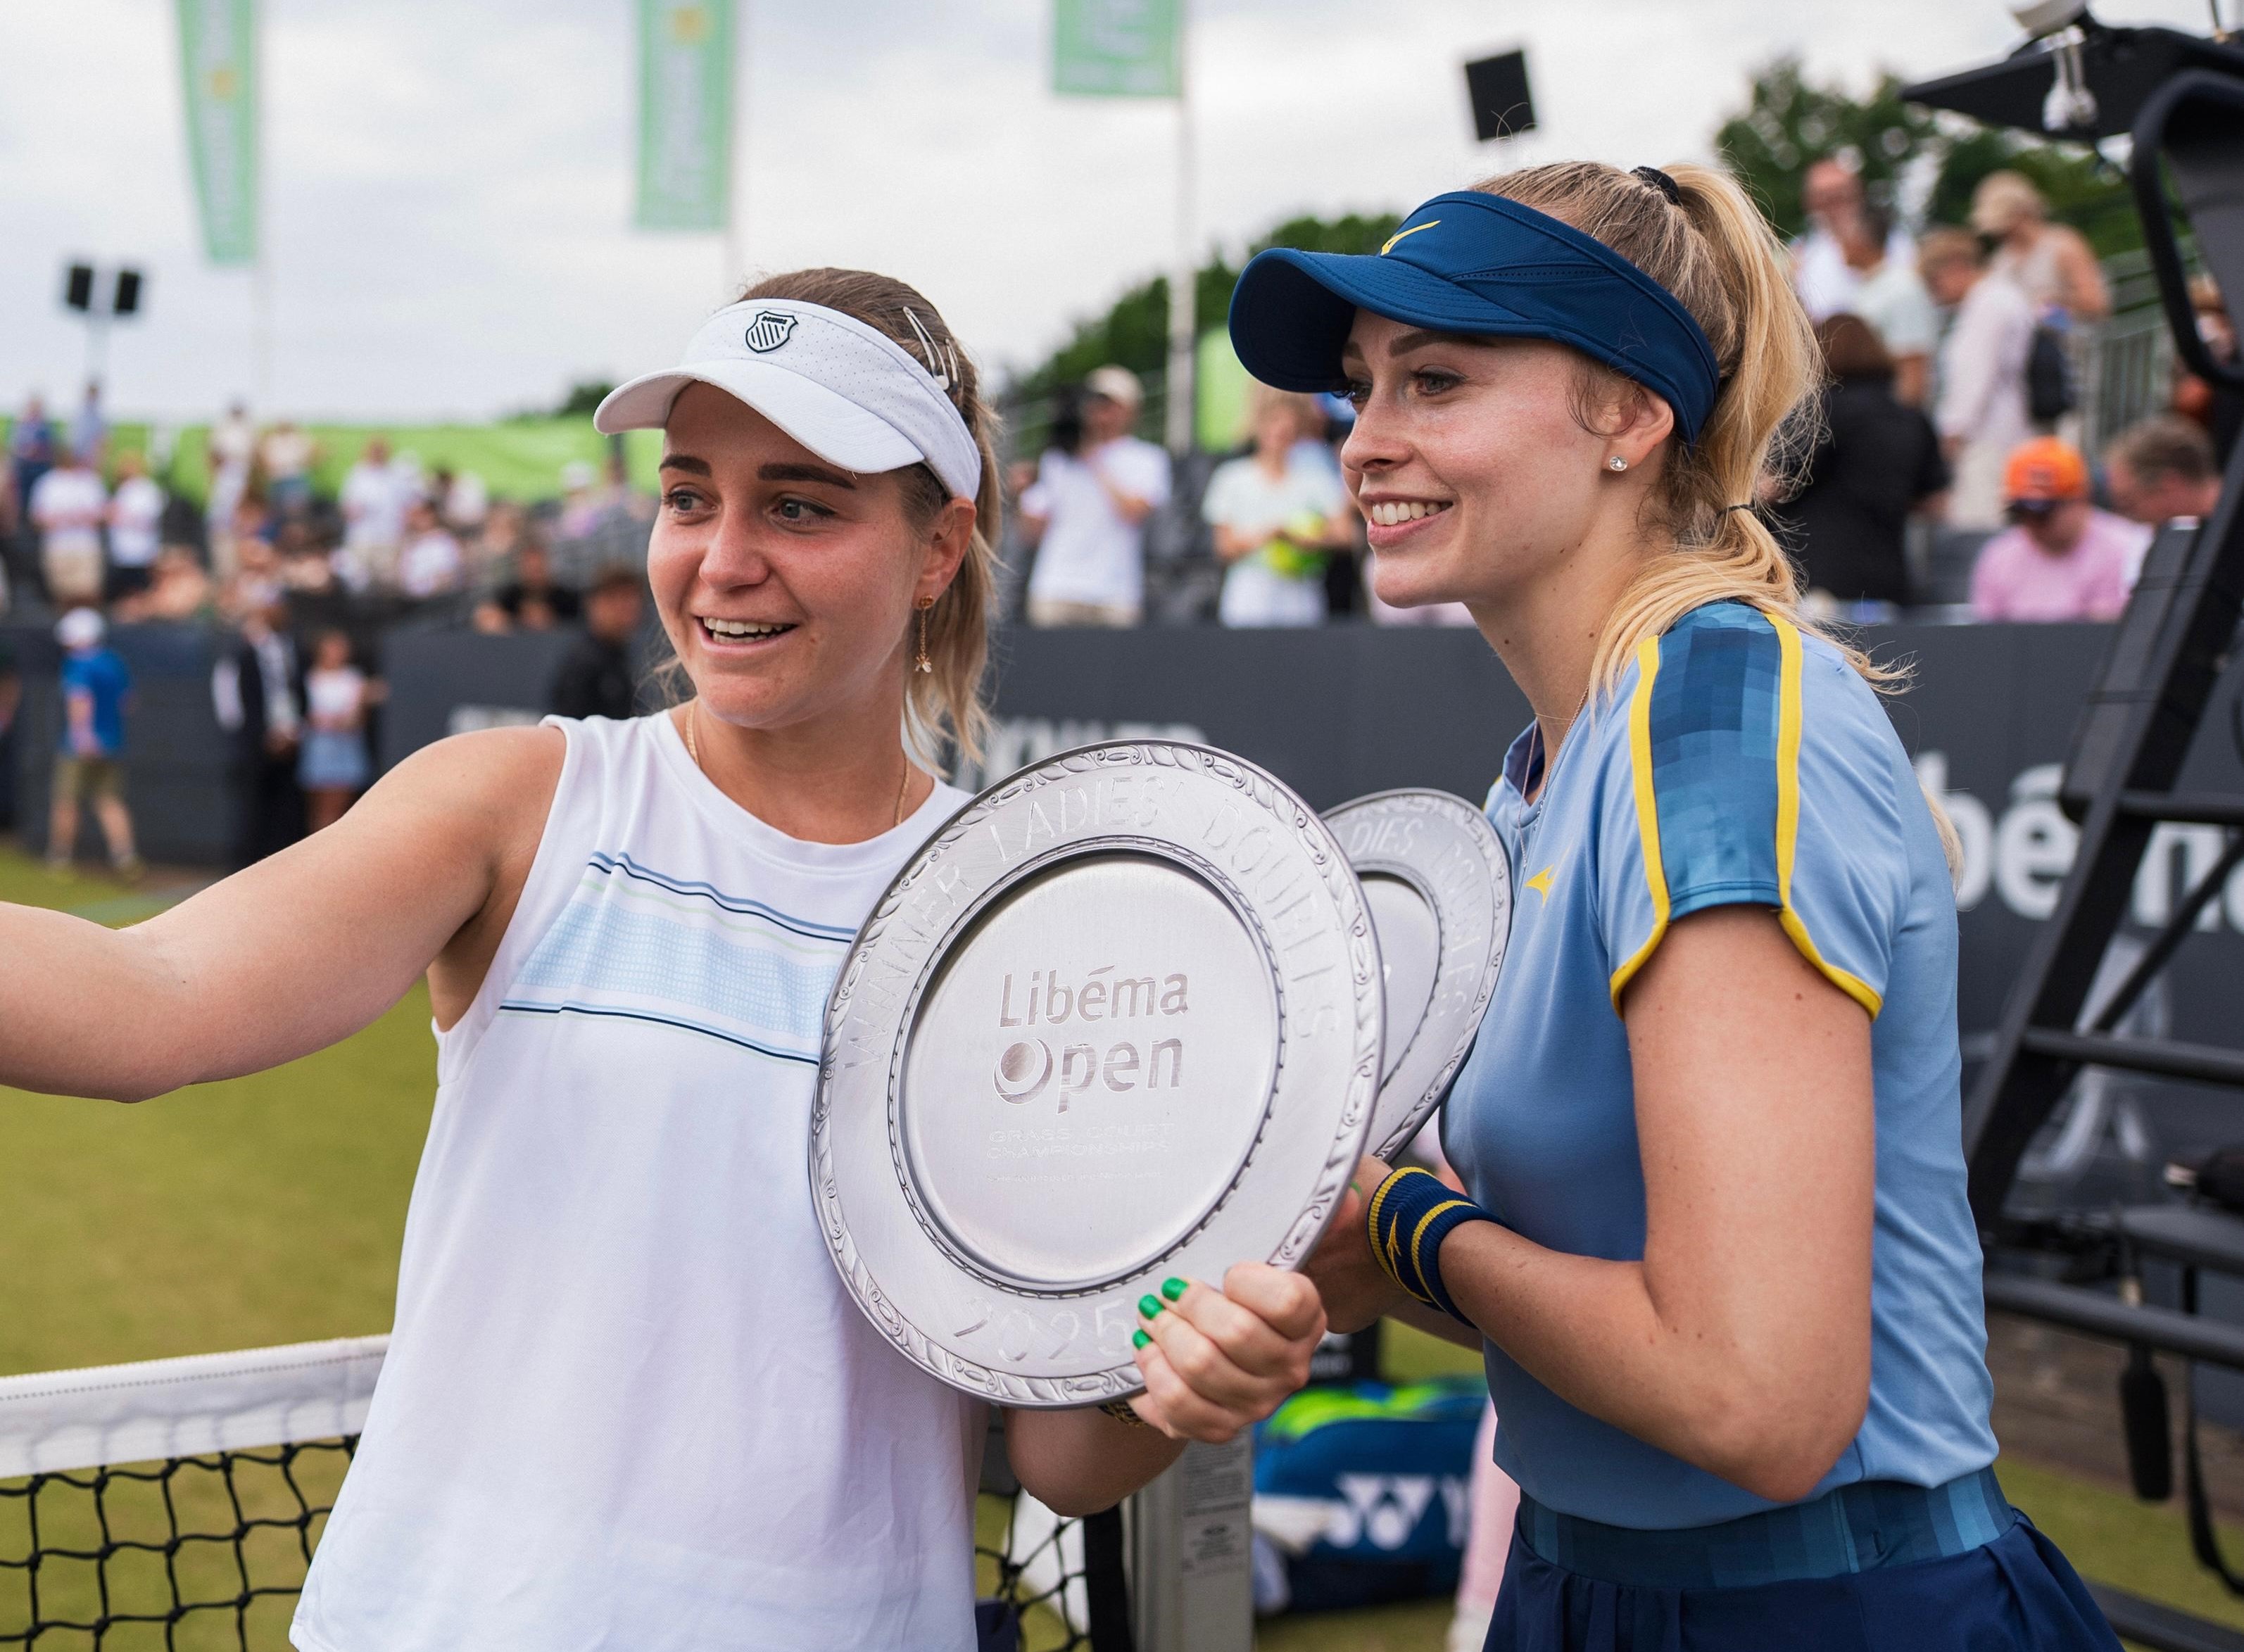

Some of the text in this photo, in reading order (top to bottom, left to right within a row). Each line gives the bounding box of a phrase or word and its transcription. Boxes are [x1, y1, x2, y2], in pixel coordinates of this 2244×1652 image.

[843, 861, 974, 1069] WINNER
[998, 964, 1189, 1028] Libéma
[992, 1037, 1183, 1115] Open
[986, 1140, 1173, 1160] CHAMPIONSHIPS
[988, 1128, 1073, 1143] GRASS
[953, 1296, 1130, 1363] 2025
